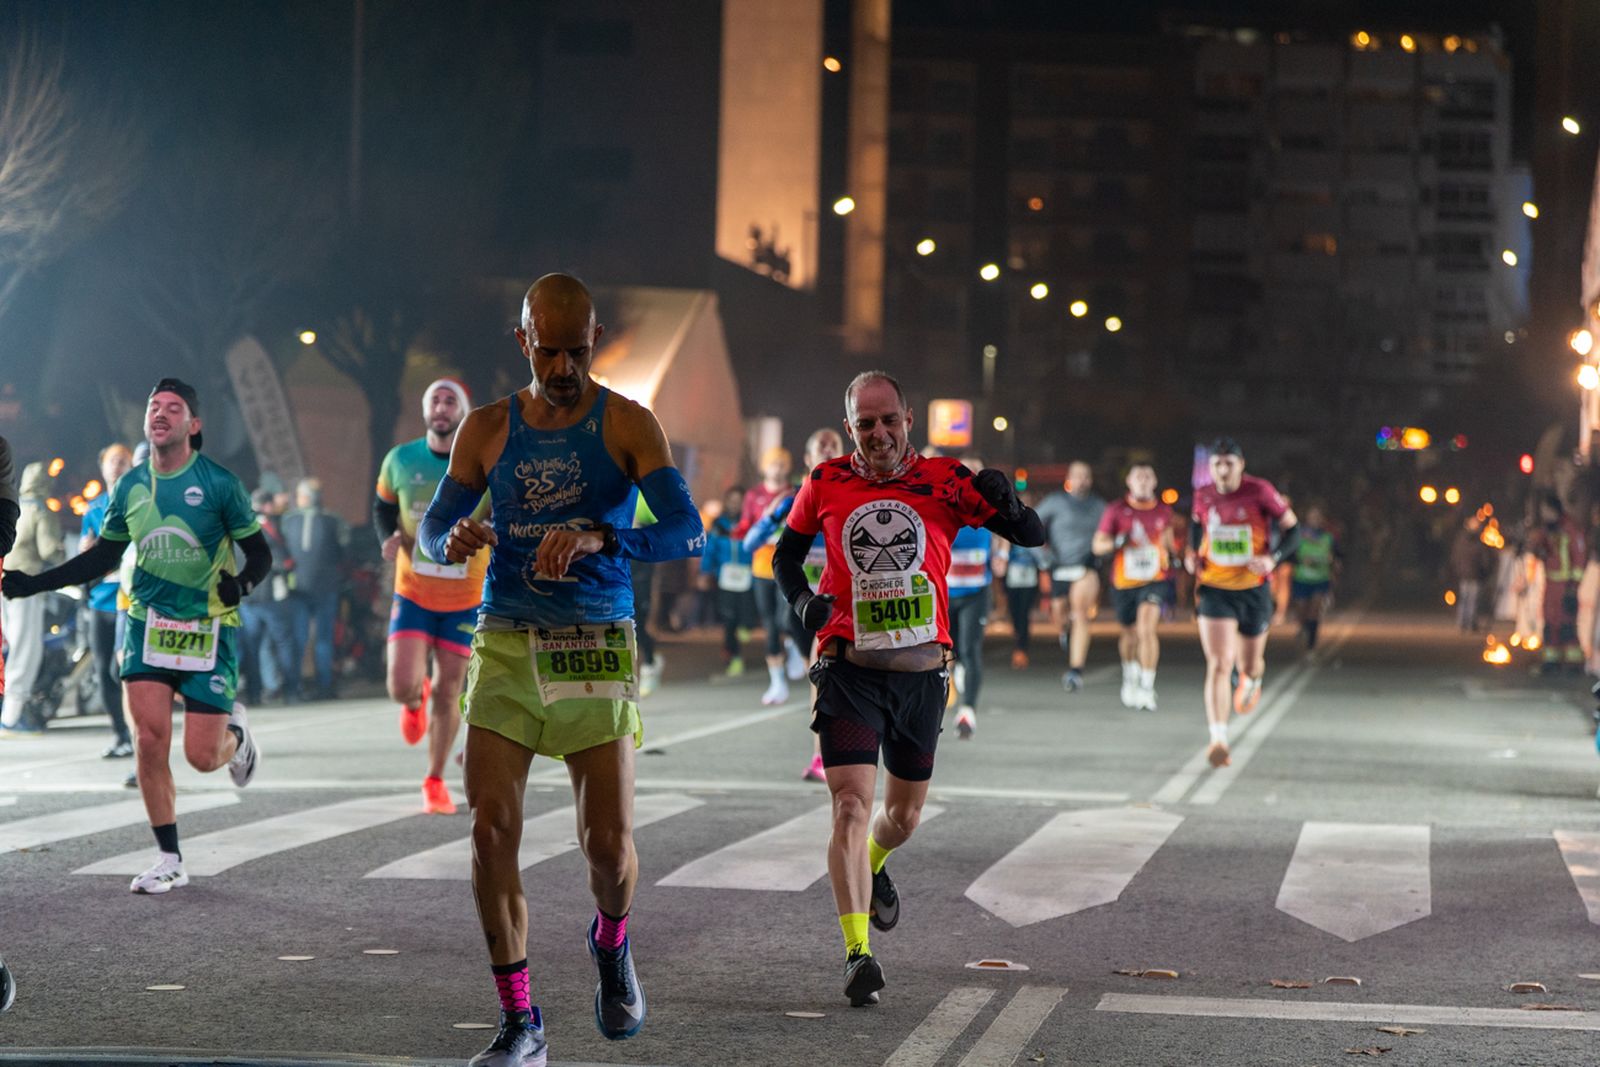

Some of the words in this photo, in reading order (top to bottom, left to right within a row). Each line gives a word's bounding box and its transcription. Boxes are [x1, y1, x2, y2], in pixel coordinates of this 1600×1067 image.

[524, 471, 555, 499] 25
[845, 511, 860, 529] LOS
[869, 581, 894, 591] NOCHE
[895, 580, 905, 588] DE
[861, 591, 877, 600] SAN
[870, 597, 920, 624] 5401
[155, 620, 168, 628] SAN
[158, 629, 205, 652] 13271
[542, 642, 562, 651] SAN
[551, 650, 619, 674] 8699
